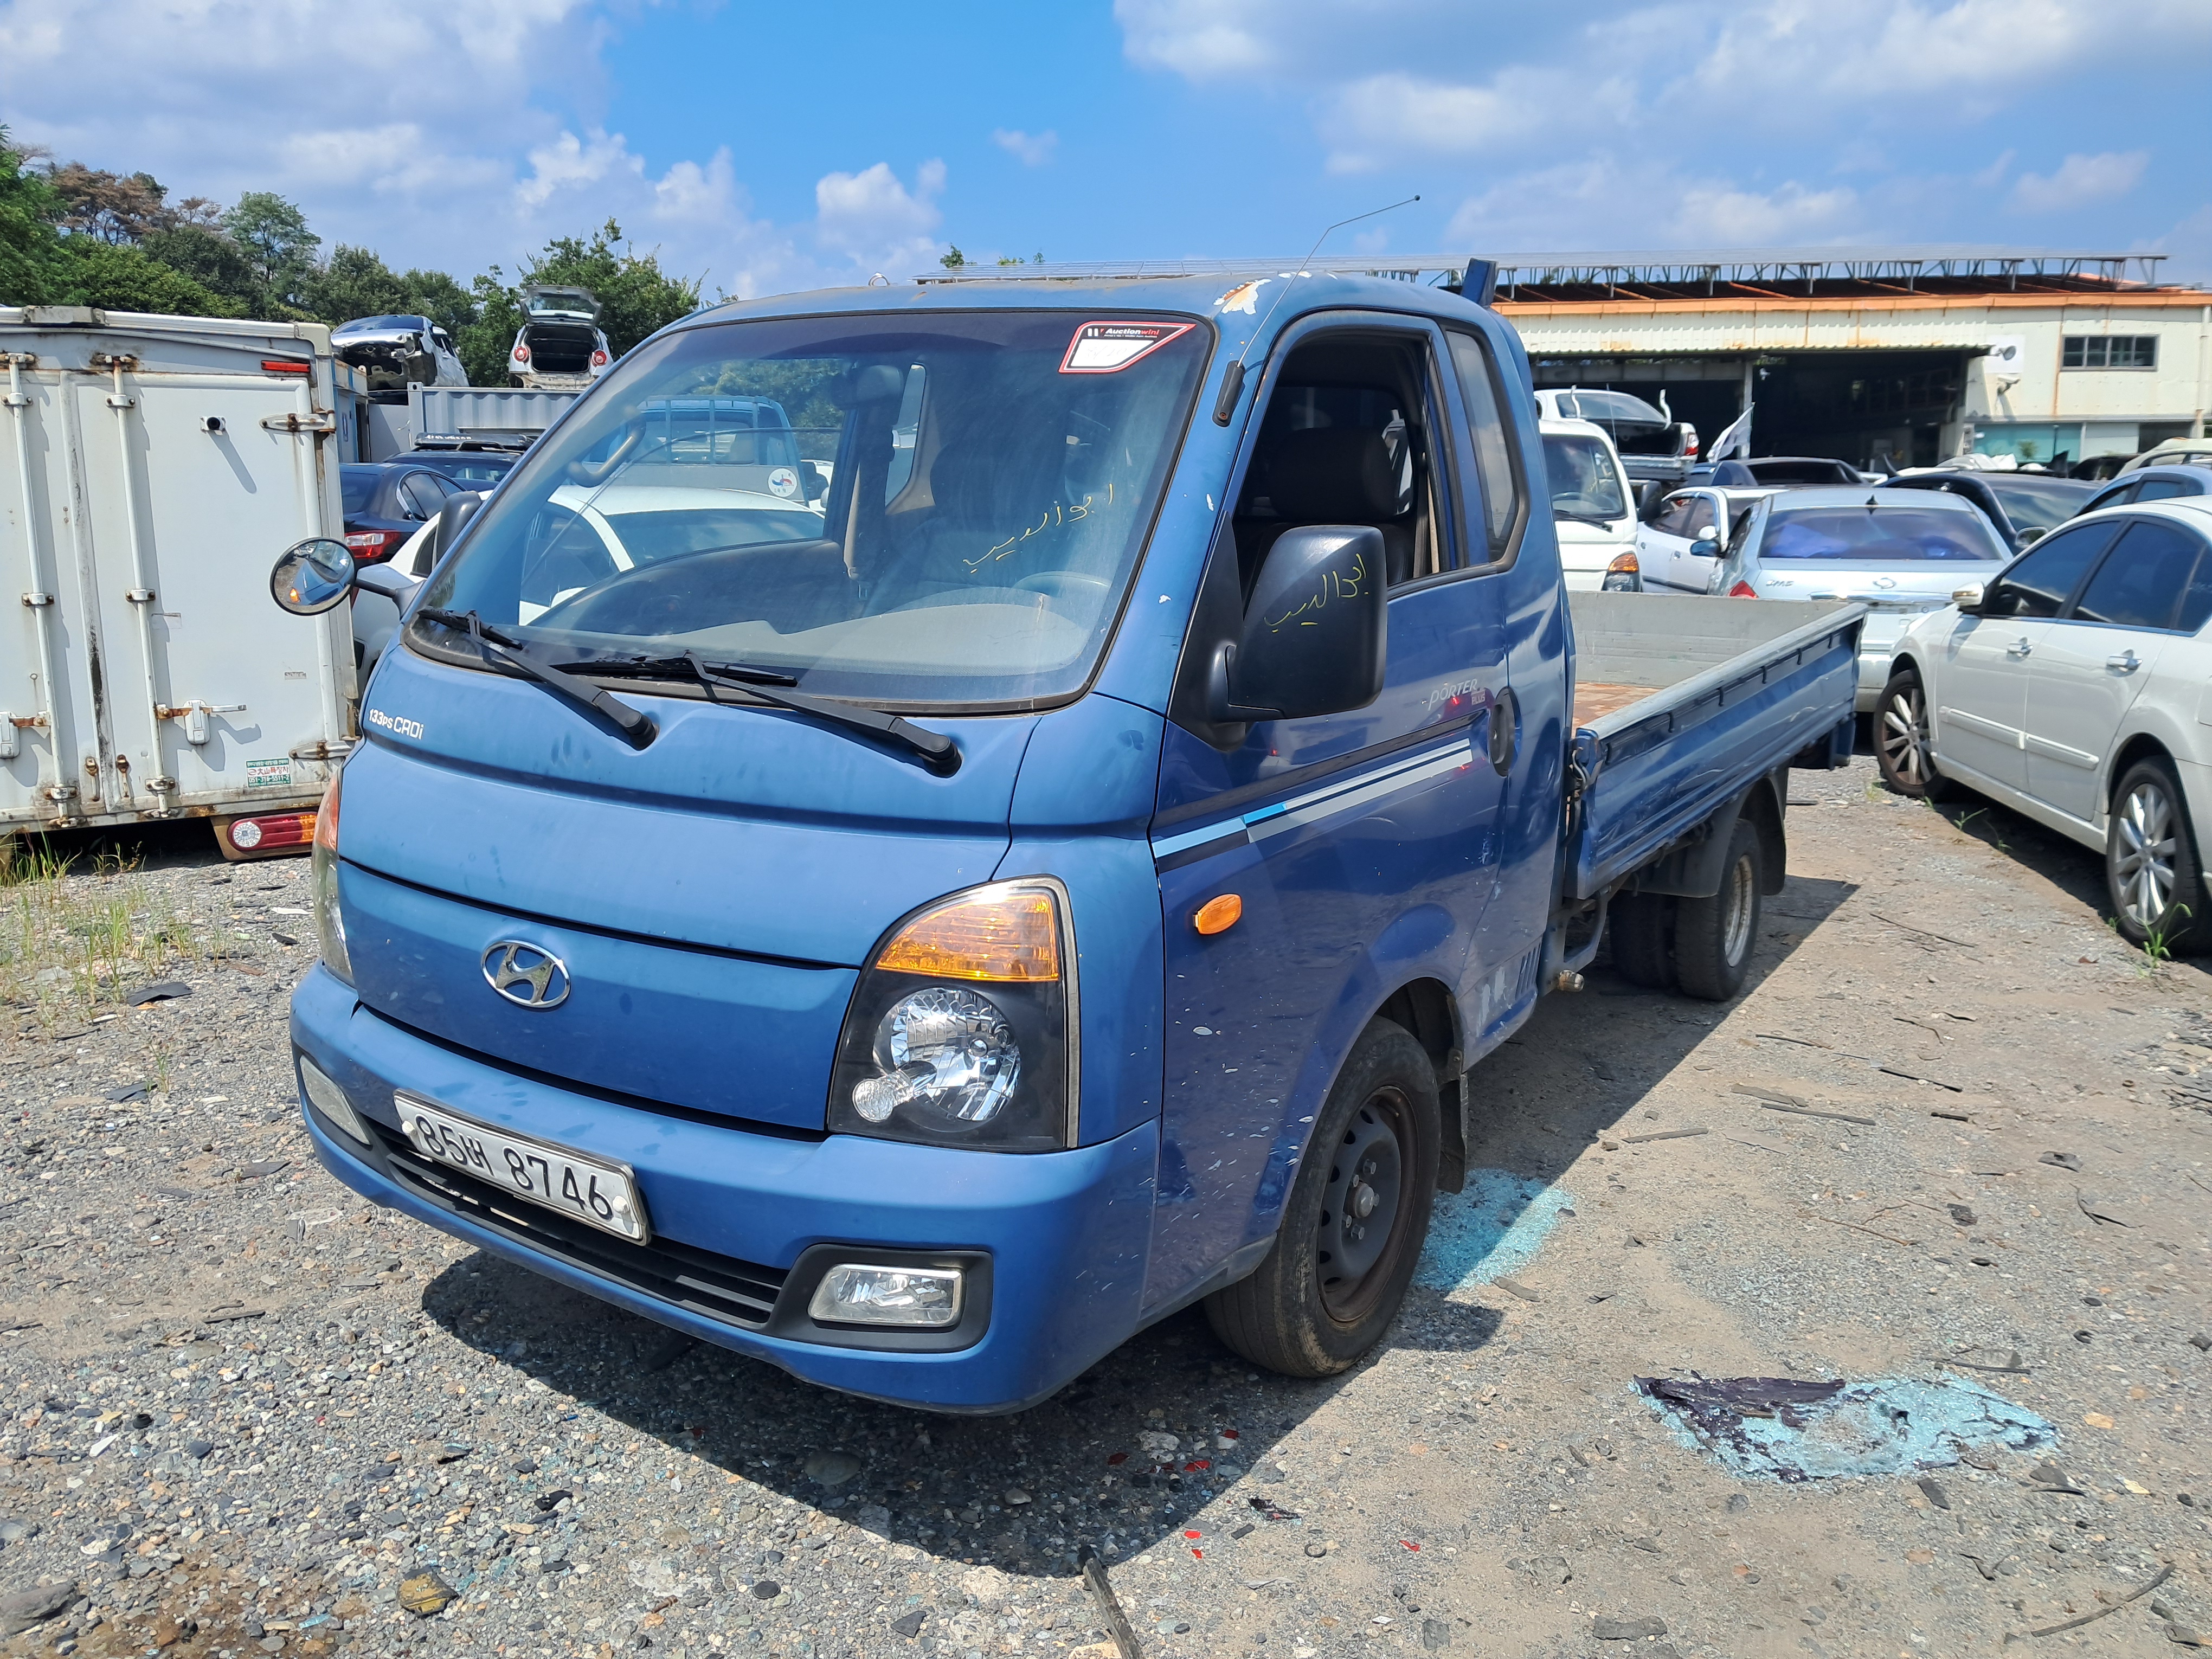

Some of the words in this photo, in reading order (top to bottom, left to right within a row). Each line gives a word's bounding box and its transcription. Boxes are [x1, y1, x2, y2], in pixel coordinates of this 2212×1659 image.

[1427, 678, 1477, 711] PORTER
[1471, 694, 1486, 705] PLUS
[415, 1114, 494, 1177] 85버
[503, 1146, 613, 1221] 8746
